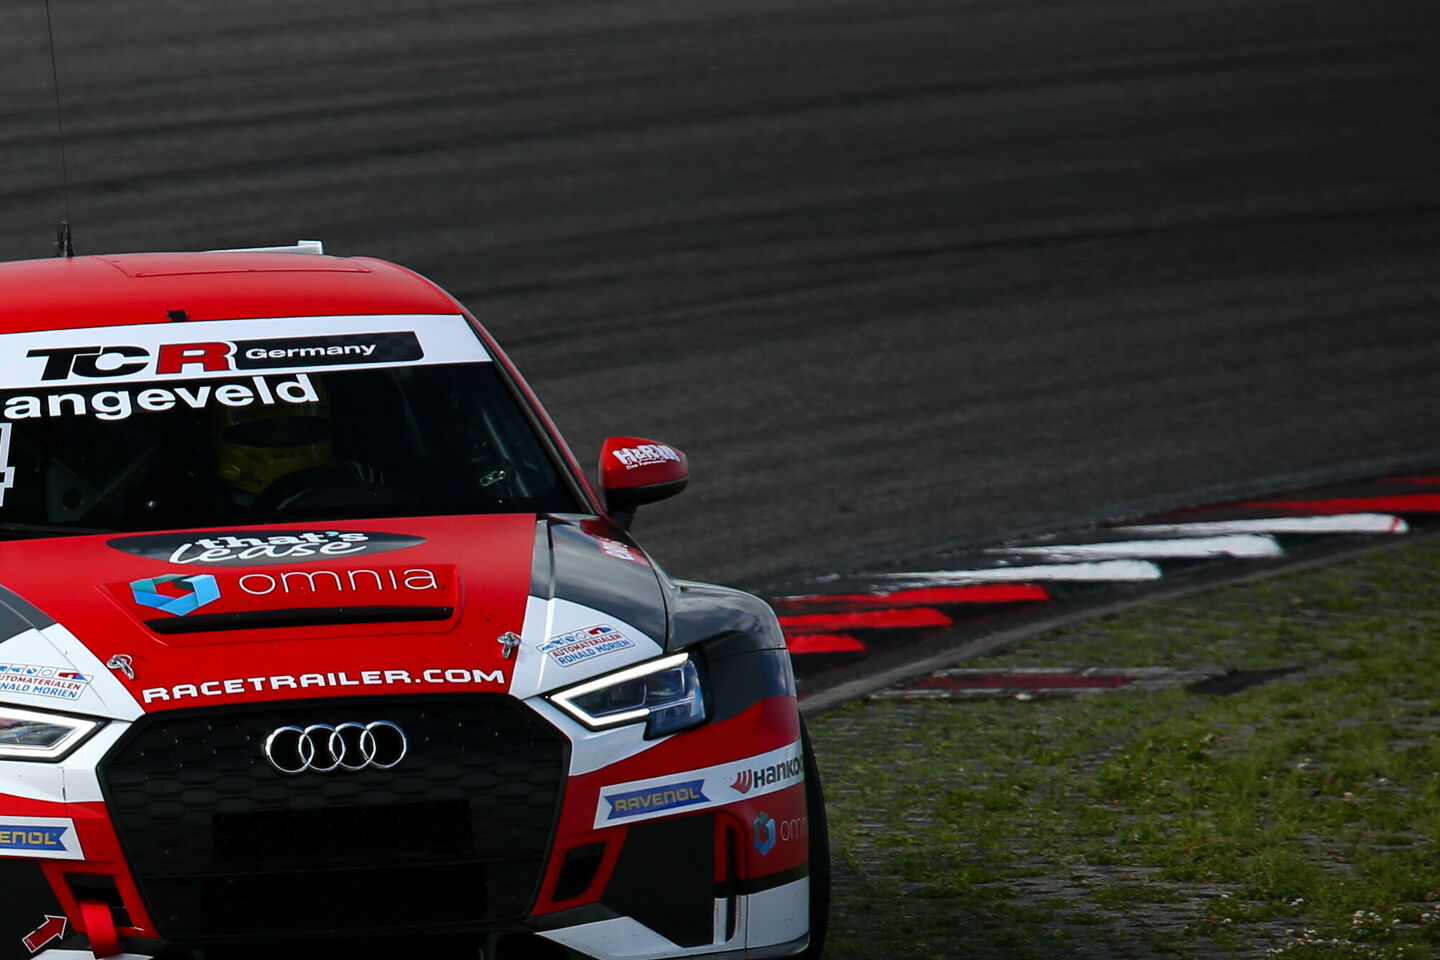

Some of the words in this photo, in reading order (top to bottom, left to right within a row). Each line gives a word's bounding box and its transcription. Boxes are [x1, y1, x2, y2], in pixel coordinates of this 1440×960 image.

[26, 341, 238, 381] TCR
[245, 341, 377, 360] Germany
[238, 568, 439, 595] omnia
[32, 686, 78, 698] MORIEN
[142, 669, 505, 704] RACETRAILER.COM
[615, 787, 701, 812] RAVENOL
